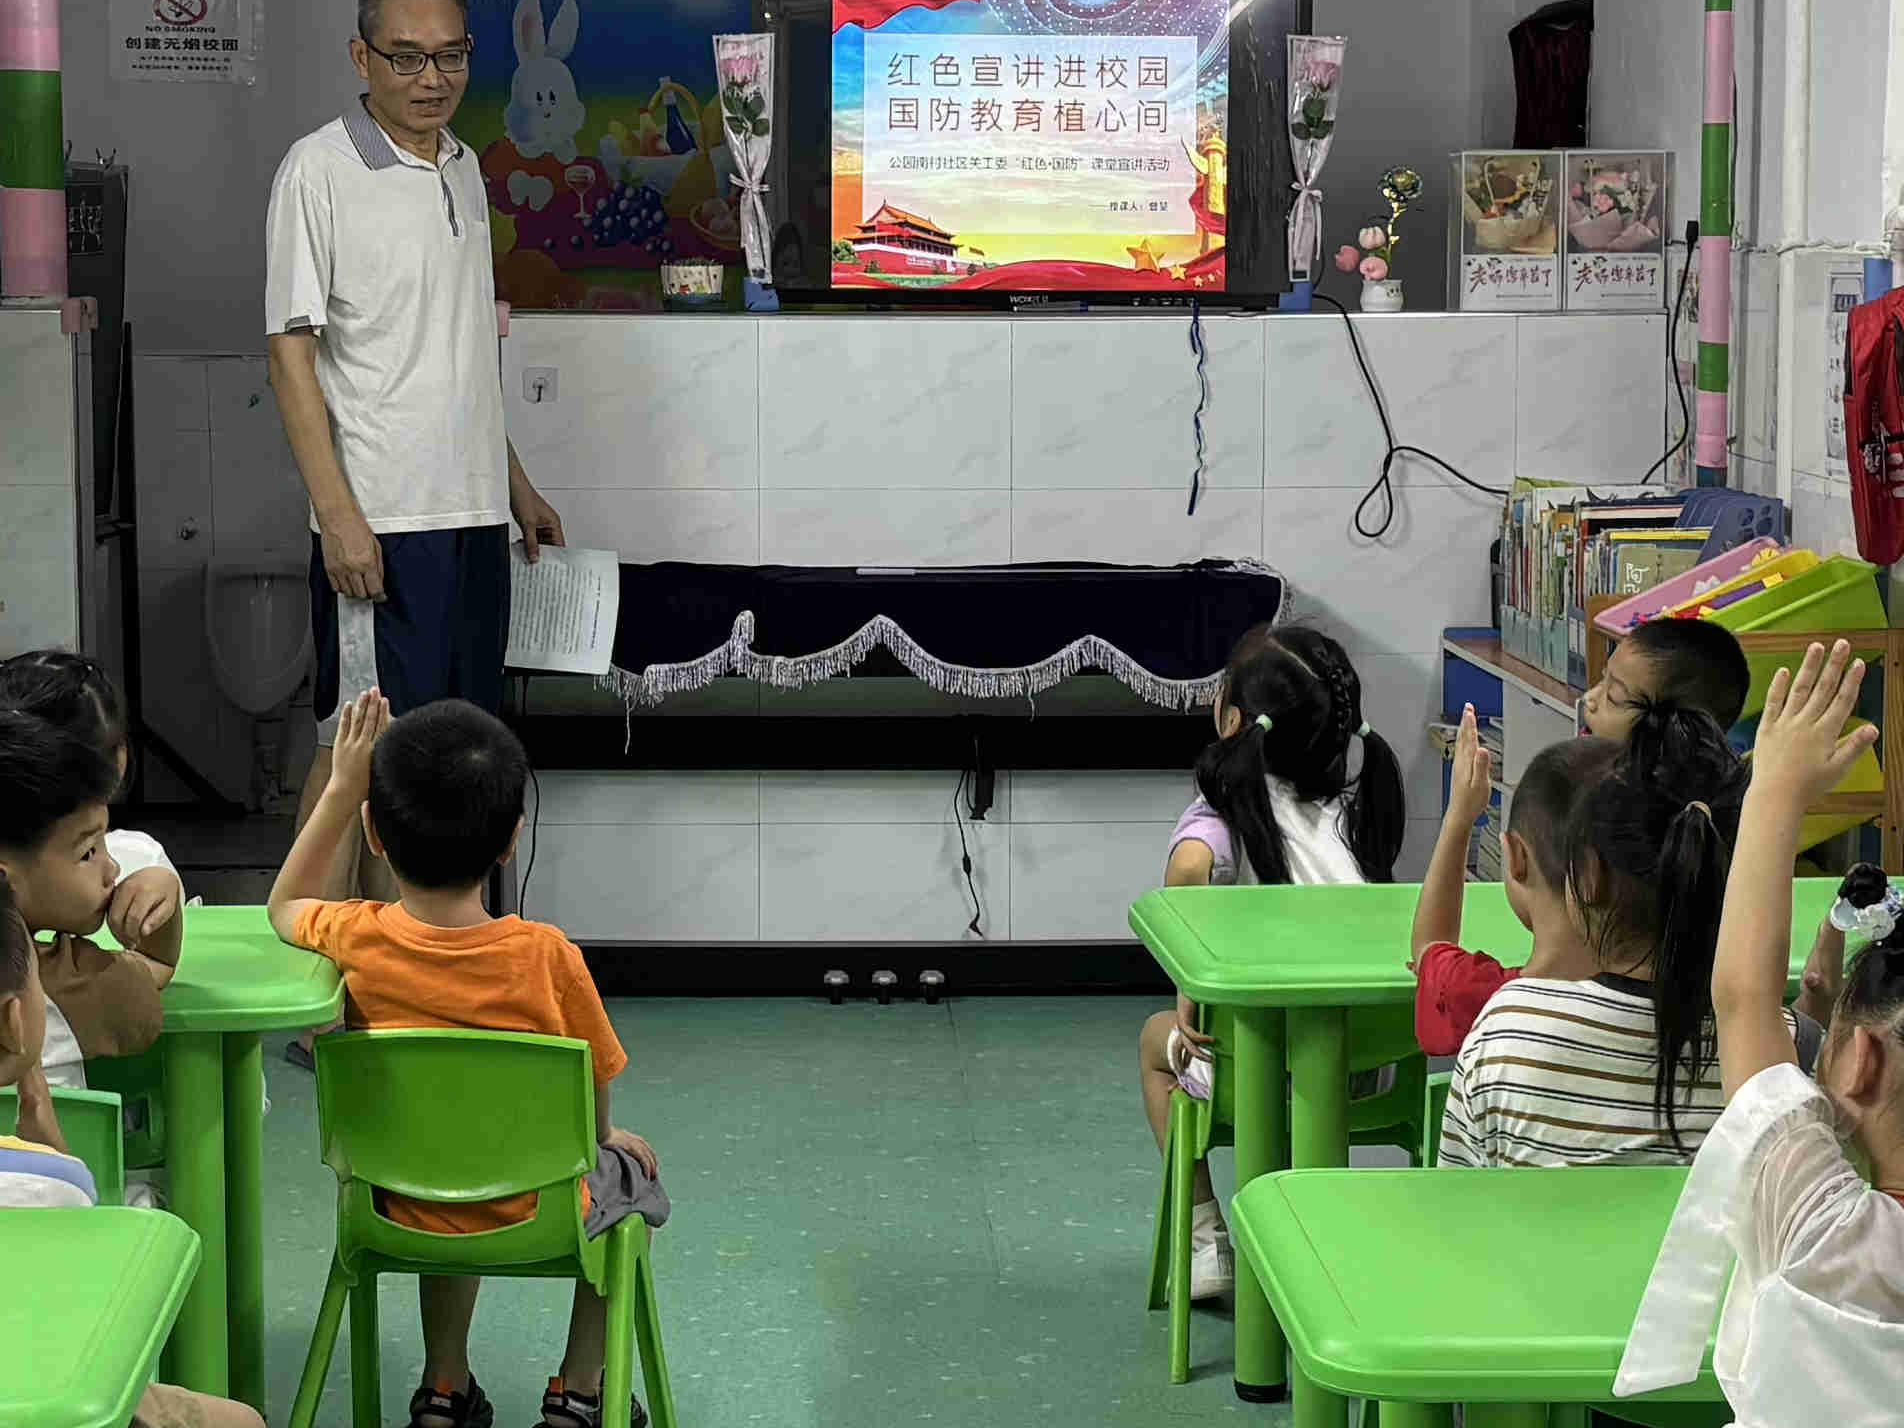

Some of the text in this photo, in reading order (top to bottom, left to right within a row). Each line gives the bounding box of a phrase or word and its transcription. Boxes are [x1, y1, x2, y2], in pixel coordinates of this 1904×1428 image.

[886, 53, 1170, 90] 红色宣讲进校园
[887, 96, 1169, 134] 国防教育植心间
